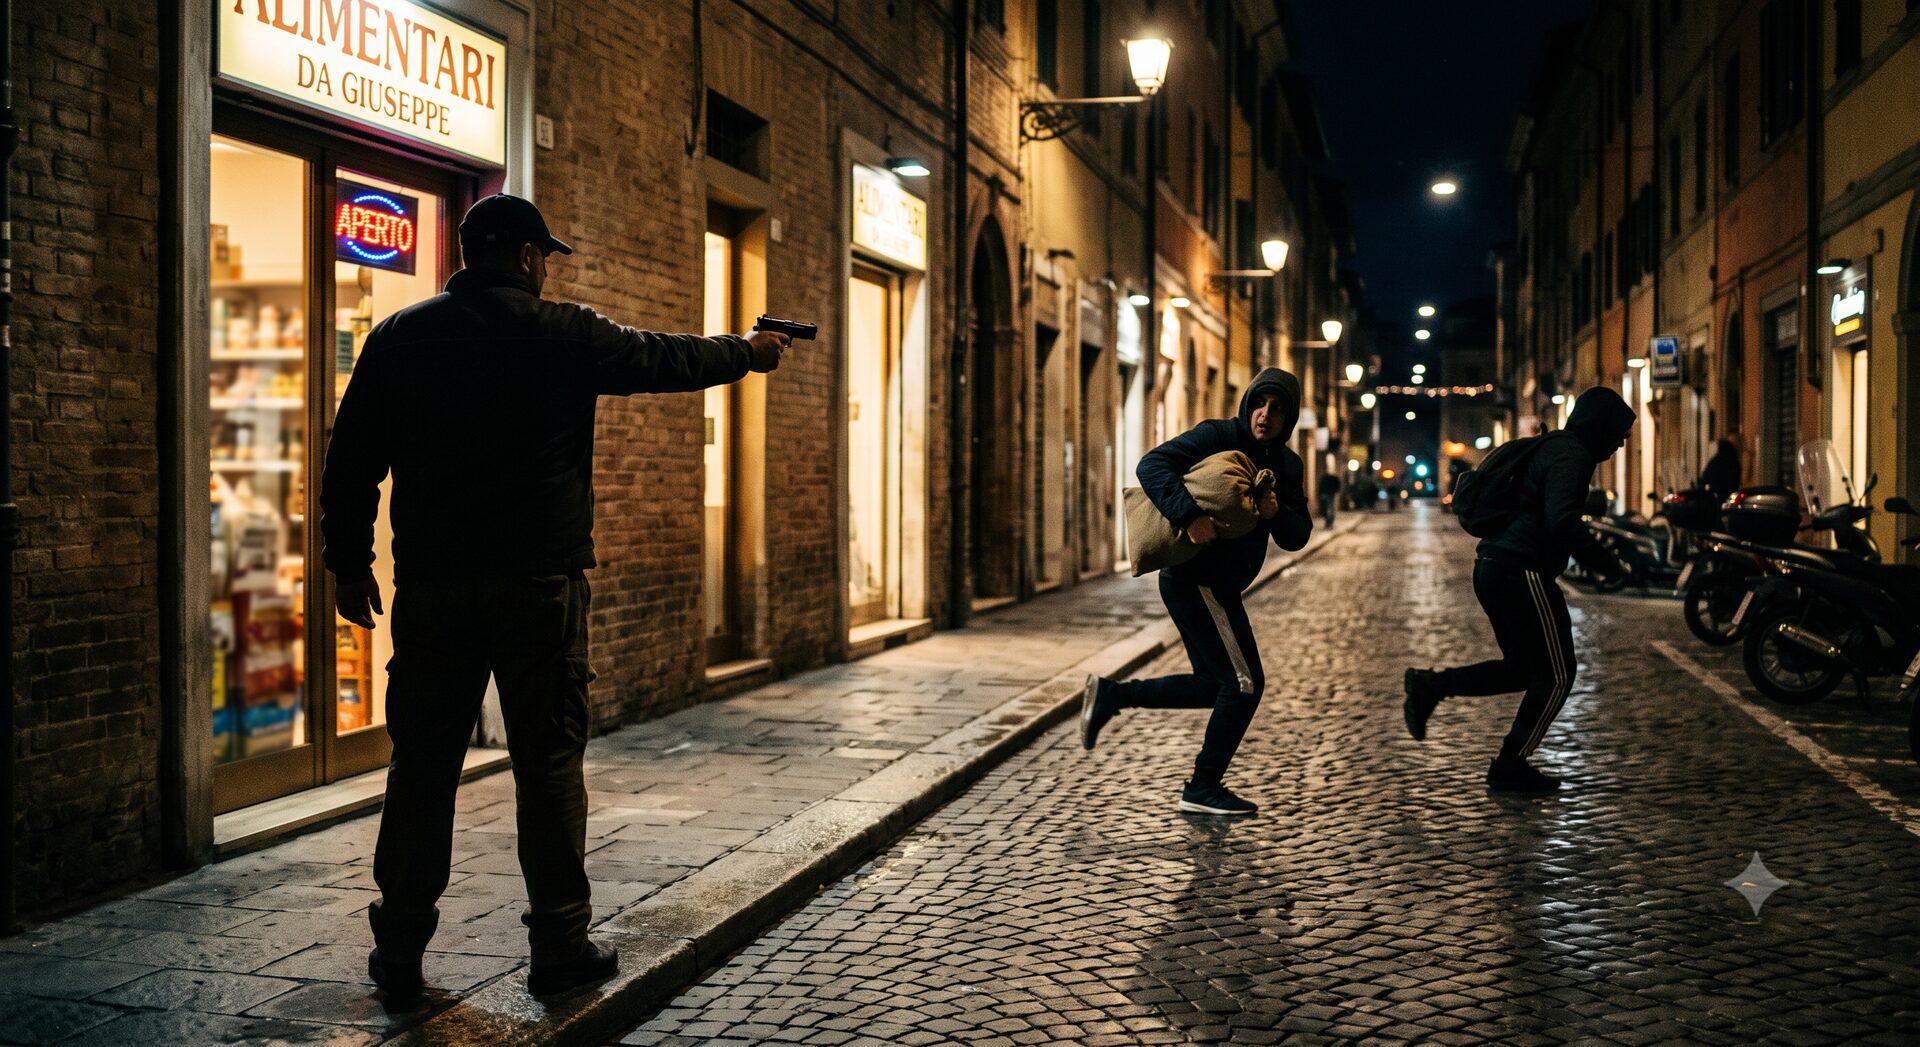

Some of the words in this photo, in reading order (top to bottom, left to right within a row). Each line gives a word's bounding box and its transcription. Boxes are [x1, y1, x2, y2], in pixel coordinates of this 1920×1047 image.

[297, 53, 333, 97] DA
[342, 71, 451, 137] GIUSEPPE
[335, 203, 413, 252] APERTO
